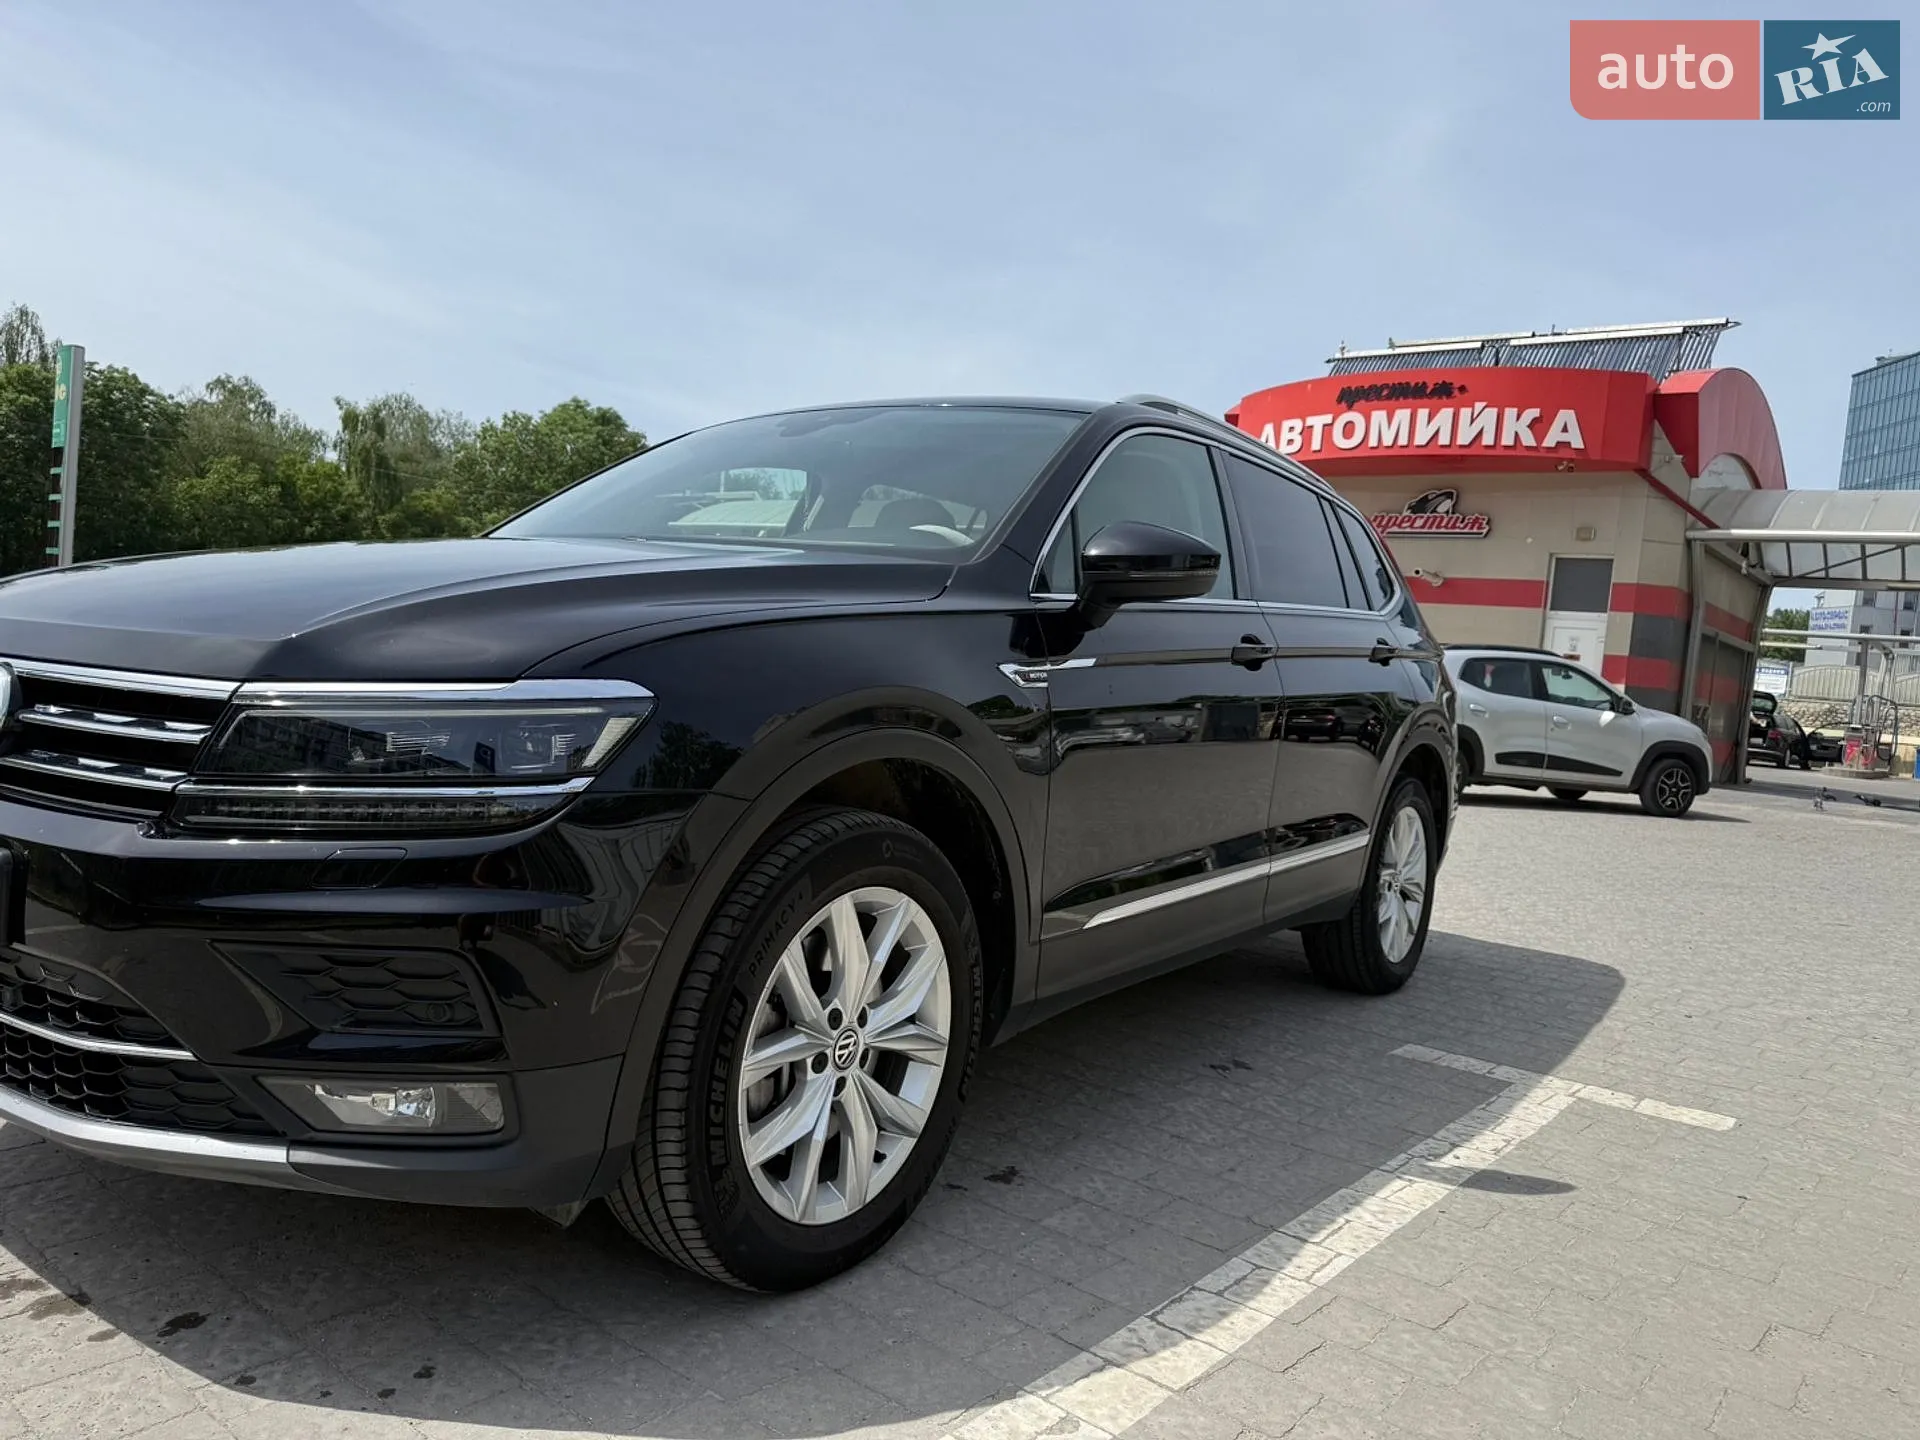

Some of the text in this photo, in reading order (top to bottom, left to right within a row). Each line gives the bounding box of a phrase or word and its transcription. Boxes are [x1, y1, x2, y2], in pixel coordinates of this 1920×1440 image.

[1259, 401, 1586, 455] АВТОМИЙКА
[749, 898, 796, 978] PRIMACY
[709, 996, 745, 1166] MICHELIN
